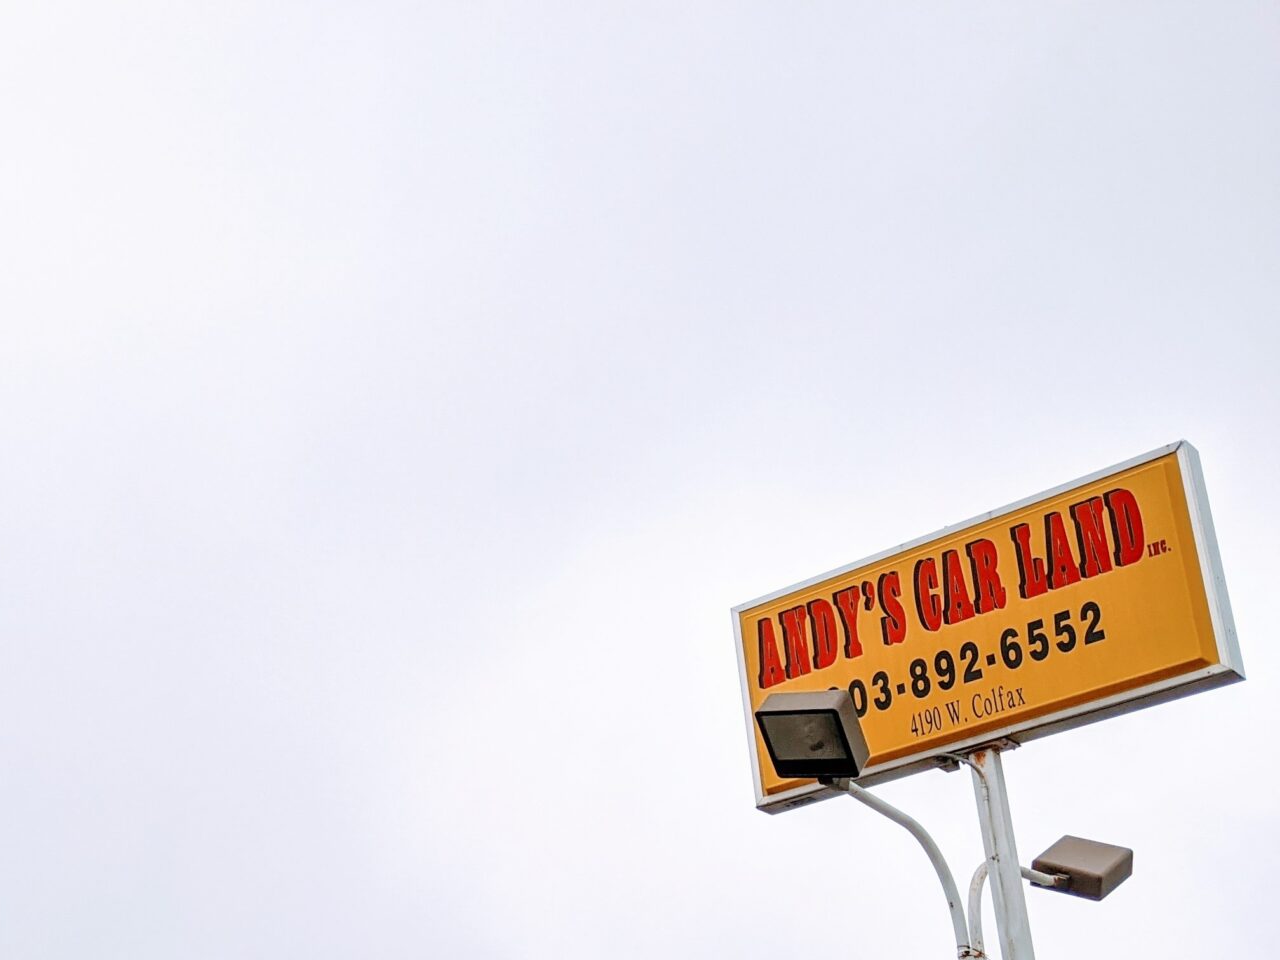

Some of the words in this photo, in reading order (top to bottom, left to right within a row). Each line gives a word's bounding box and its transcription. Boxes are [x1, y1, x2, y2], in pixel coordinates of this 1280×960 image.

[757, 571, 906, 689] ANDY'S
[913, 538, 1007, 632] CAR
[1010, 488, 1145, 599] LAND
[1147, 539, 1172, 558] INC.
[828, 601, 1106, 718] 03-892-6552
[911, 706, 942, 737] 4190
[945, 700, 968, 726] W.
[972, 685, 1026, 719] Colfax
